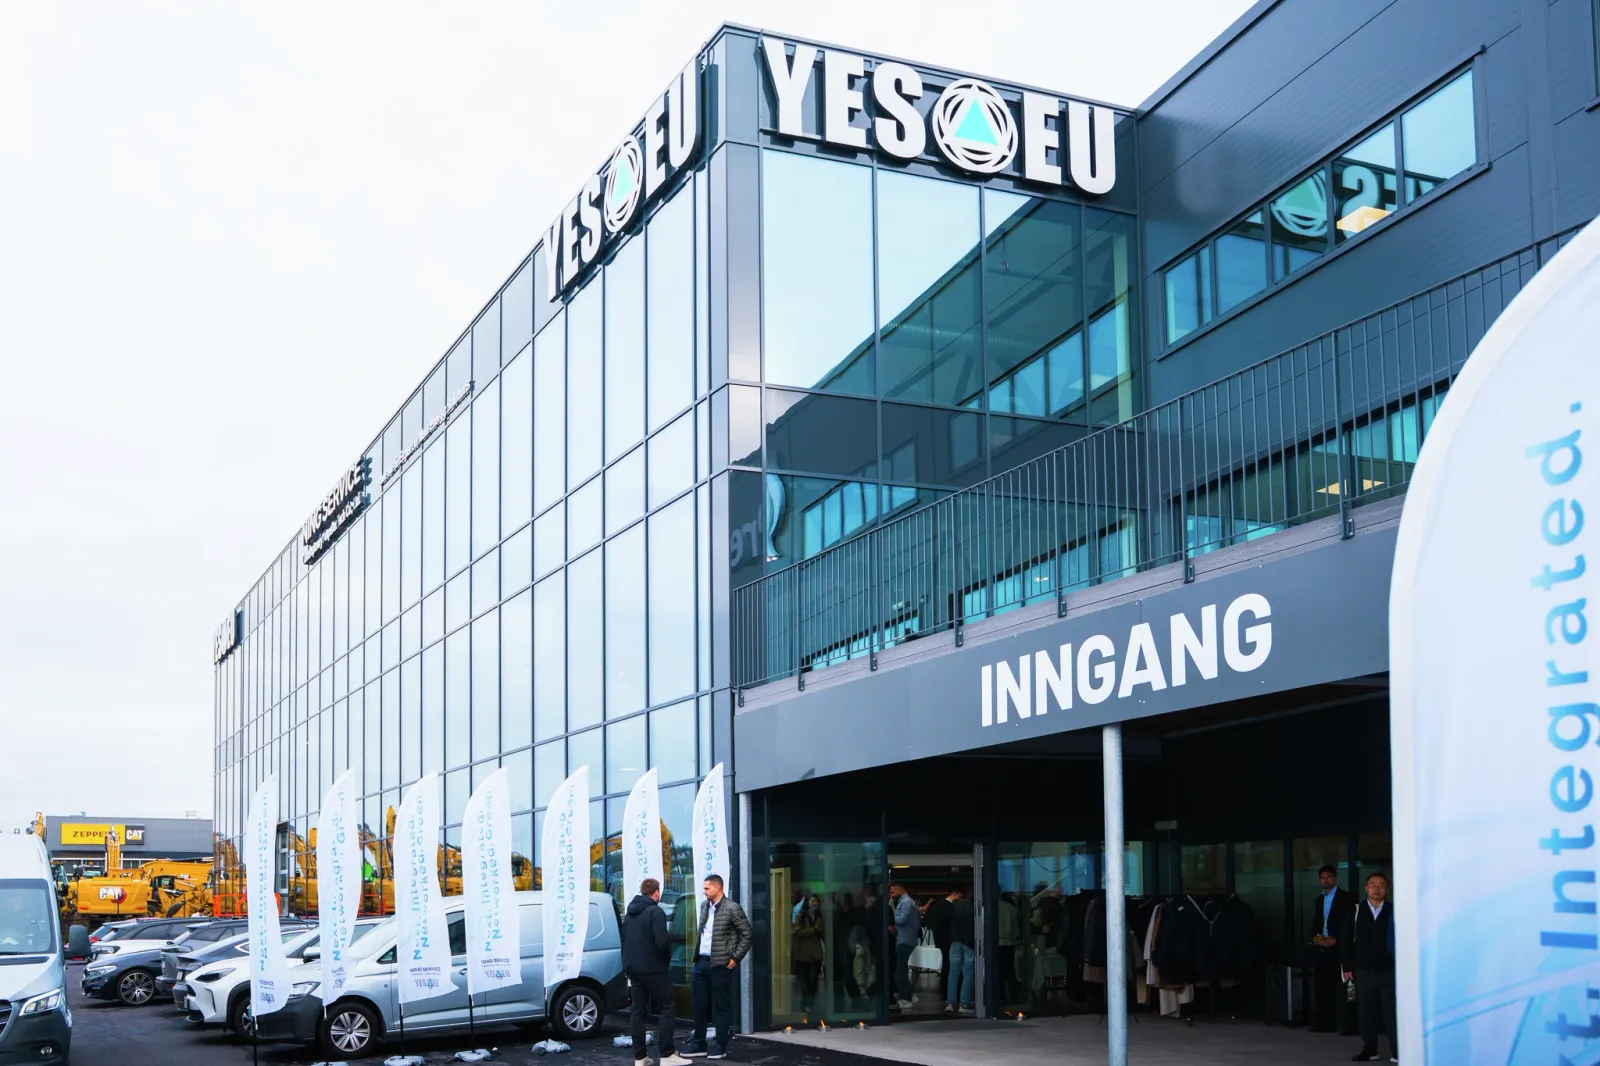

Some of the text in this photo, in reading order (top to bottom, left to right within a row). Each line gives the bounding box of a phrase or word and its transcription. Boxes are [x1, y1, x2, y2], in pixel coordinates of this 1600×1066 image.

[543, 54, 698, 303] YES EU
[759, 36, 1116, 194] YES EU
[981, 592, 1273, 727] INNGANG
[99, 887, 122, 900] CAT
[126, 830, 144, 840] CAT
